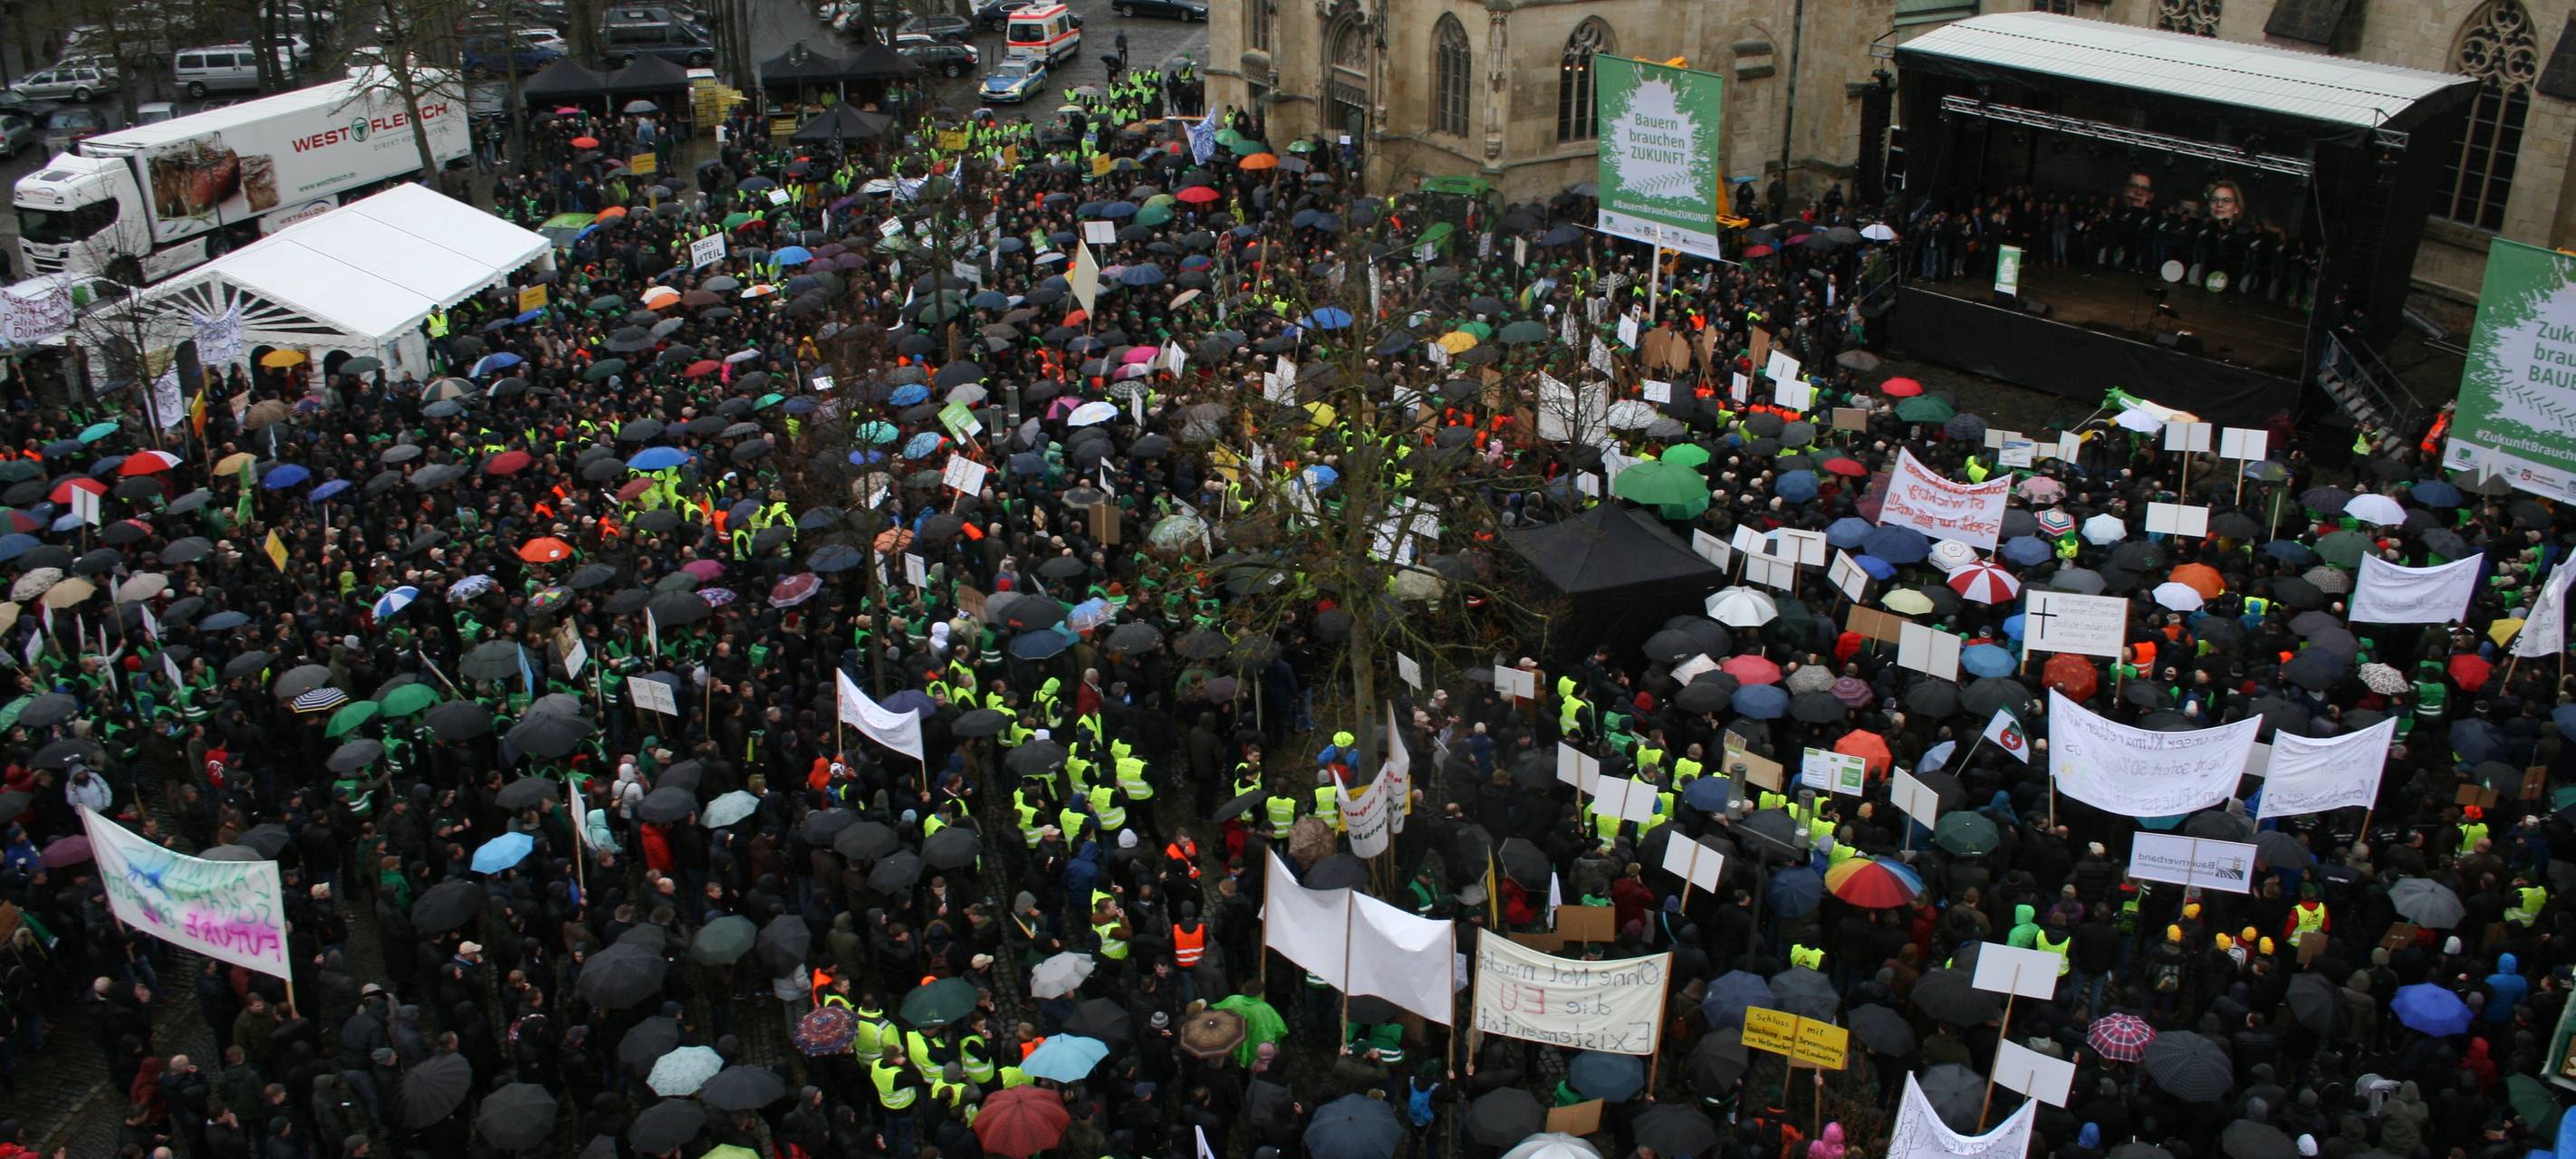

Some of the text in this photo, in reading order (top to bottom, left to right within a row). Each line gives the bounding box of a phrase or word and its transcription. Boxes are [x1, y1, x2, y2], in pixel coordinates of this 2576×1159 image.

[292, 101, 448, 153] WEST FLEICH
[1634, 113, 1678, 130] Bauern
[1629, 128, 1686, 149] brauchen
[1630, 147, 1686, 166] ZUKUNFT
[279, 206, 326, 225] WETRALOG
[2536, 320, 2576, 344] Zuk
[2475, 428, 2576, 463] #ZukunftBrauch
[1756, 1013, 1824, 1038] Schluss mit
